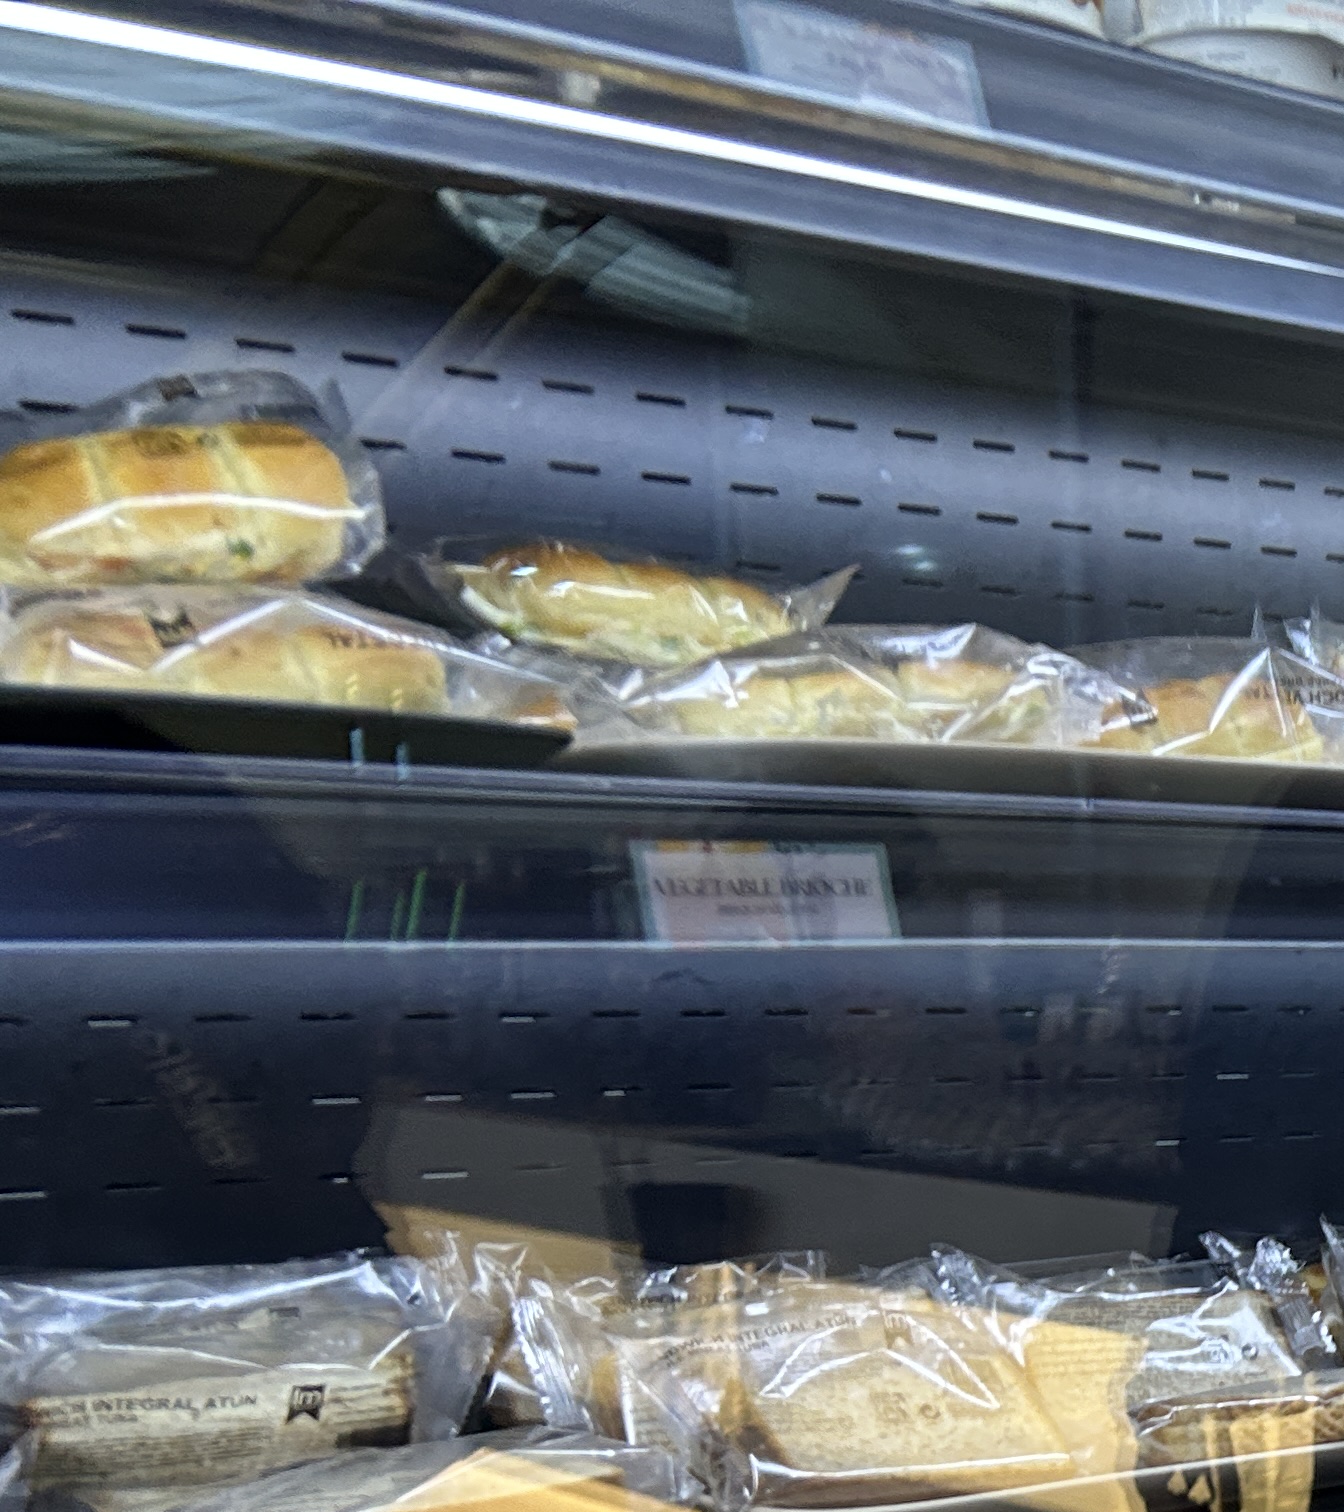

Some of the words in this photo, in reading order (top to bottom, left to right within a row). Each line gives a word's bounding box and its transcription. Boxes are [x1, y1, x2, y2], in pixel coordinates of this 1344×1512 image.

[653, 876, 772, 897] VEGETABLE
[93, 1396, 194, 1412] INTEGRAL
[205, 1394, 257, 1409] ATUN
